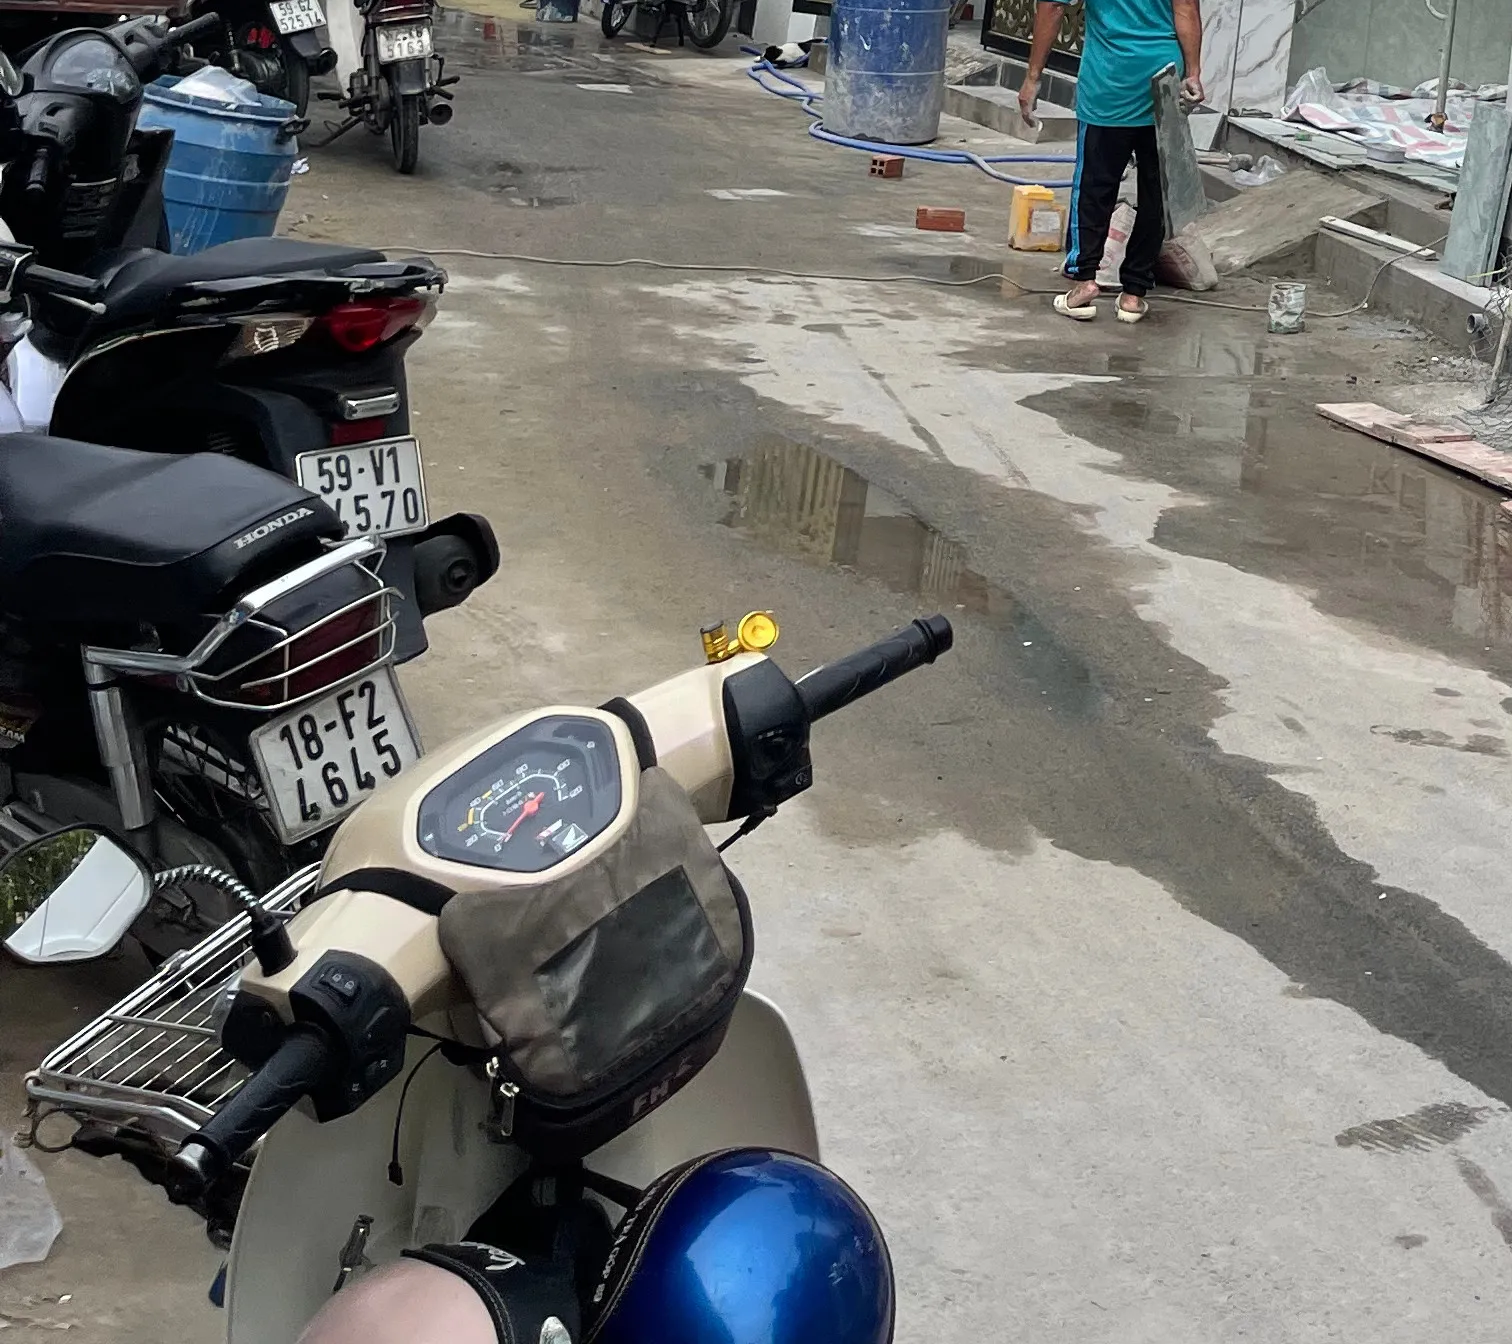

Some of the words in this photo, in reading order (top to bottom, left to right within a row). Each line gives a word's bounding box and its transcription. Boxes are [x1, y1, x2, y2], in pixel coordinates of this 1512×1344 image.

[317, 446, 401, 494] 59-V1
[232, 507, 316, 550] HONDA
[280, 680, 386, 770] 18-F2
[296, 729, 402, 821] 4645
